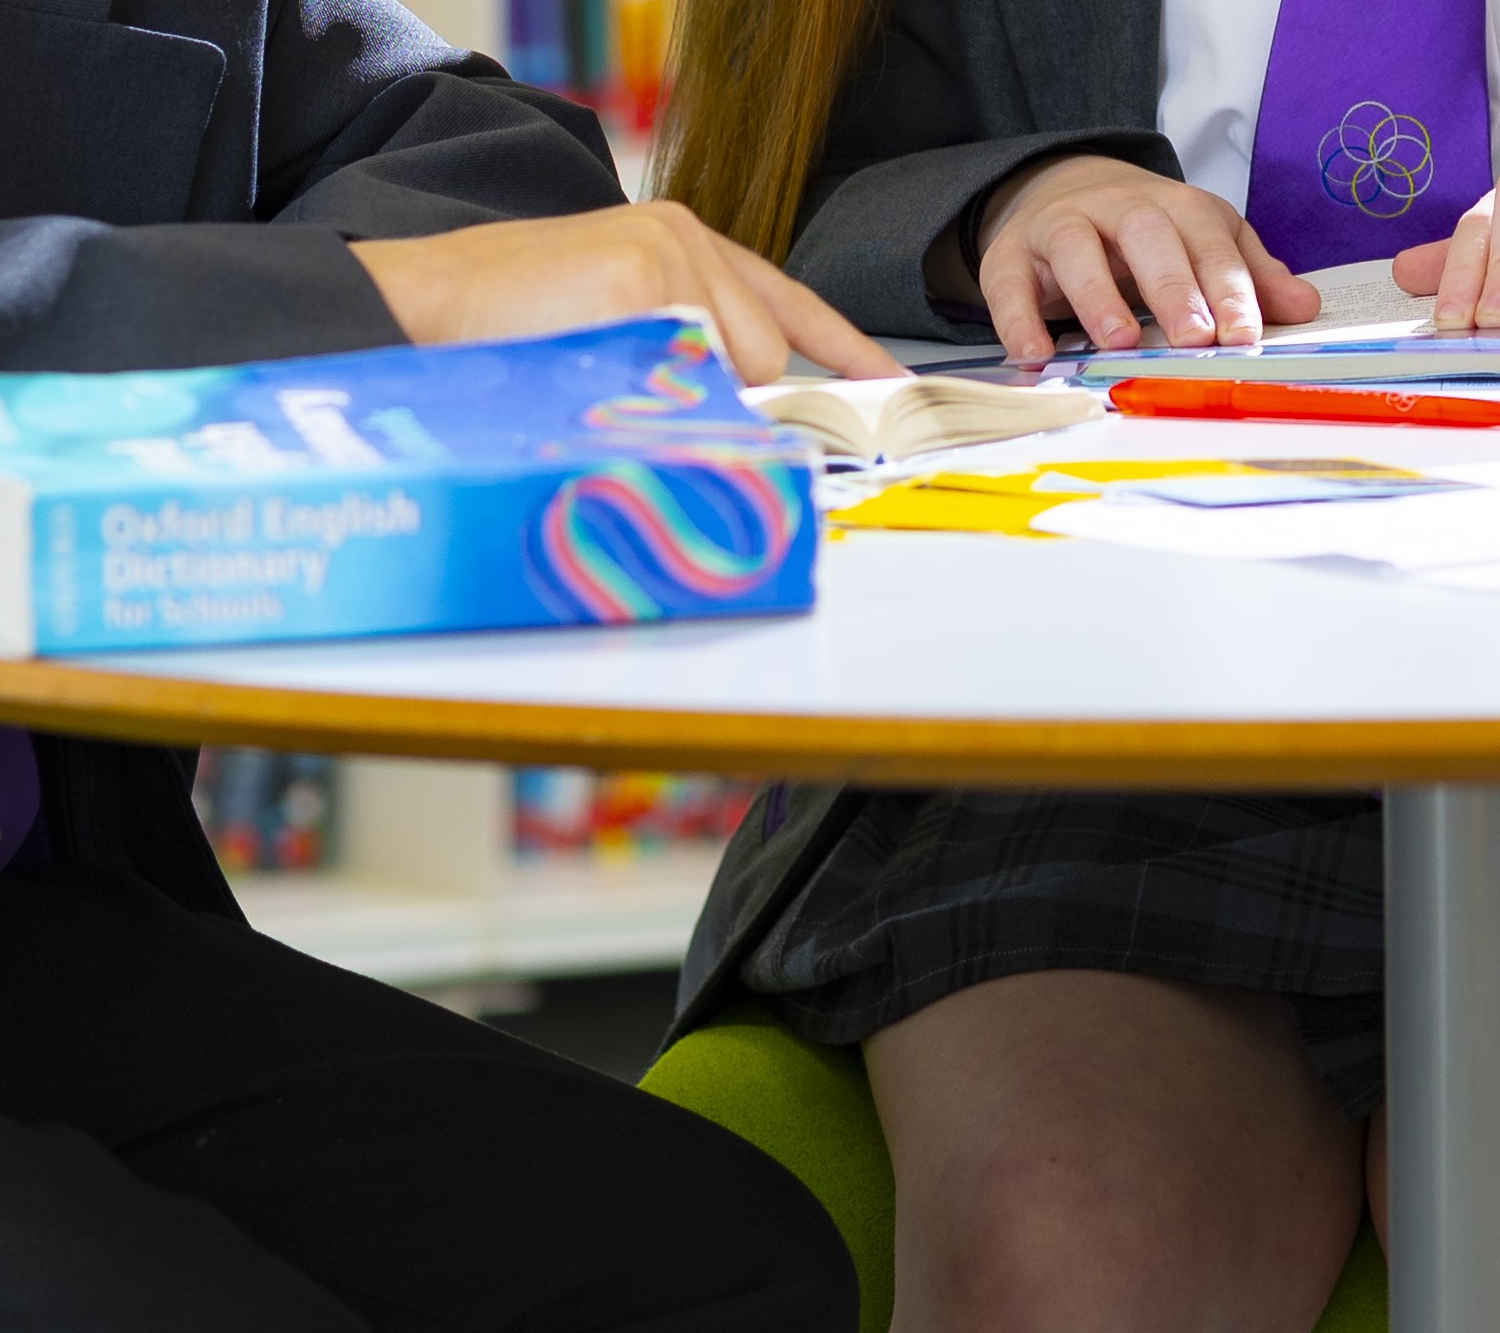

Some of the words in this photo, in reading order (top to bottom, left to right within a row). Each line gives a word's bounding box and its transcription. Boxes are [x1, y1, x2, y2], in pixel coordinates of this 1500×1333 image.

[104, 497, 252, 544] Oxford
[265, 489, 420, 546] English
[105, 548, 329, 593] Dictionary
[106, 593, 151, 625] for
[159, 591, 282, 623] Schools
